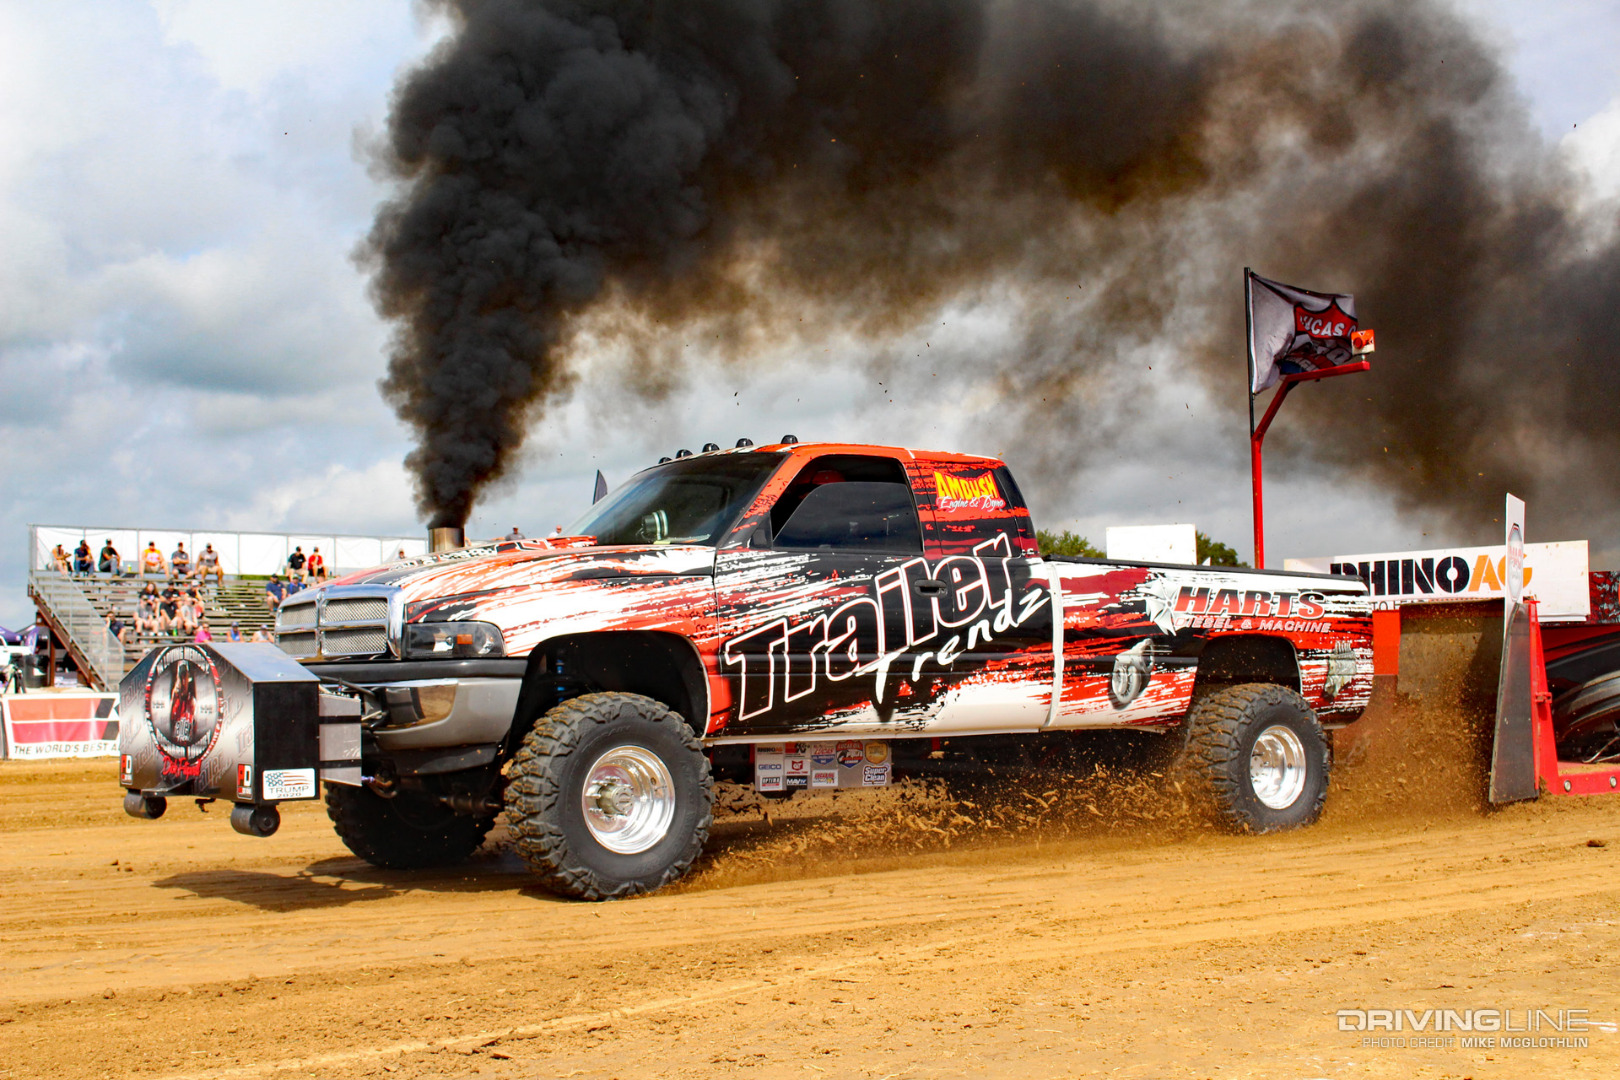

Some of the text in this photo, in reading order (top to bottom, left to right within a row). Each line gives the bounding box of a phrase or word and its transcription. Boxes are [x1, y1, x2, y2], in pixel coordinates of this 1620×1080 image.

[936, 495, 969, 513] Engine
[1173, 585, 1326, 620] HARTS
[725, 532, 1012, 721] Trailer
[1174, 616, 1332, 634] DIESEL & MACHINE
[854, 587, 1051, 704] Trendz
[14, 745, 32, 755] THE
[35, 743, 80, 754] WORLD'S
[82, 742, 108, 753] BEST
[864, 766, 887, 776] Super
[864, 773, 885, 782] Clean
[269, 785, 310, 795] TRUMP
